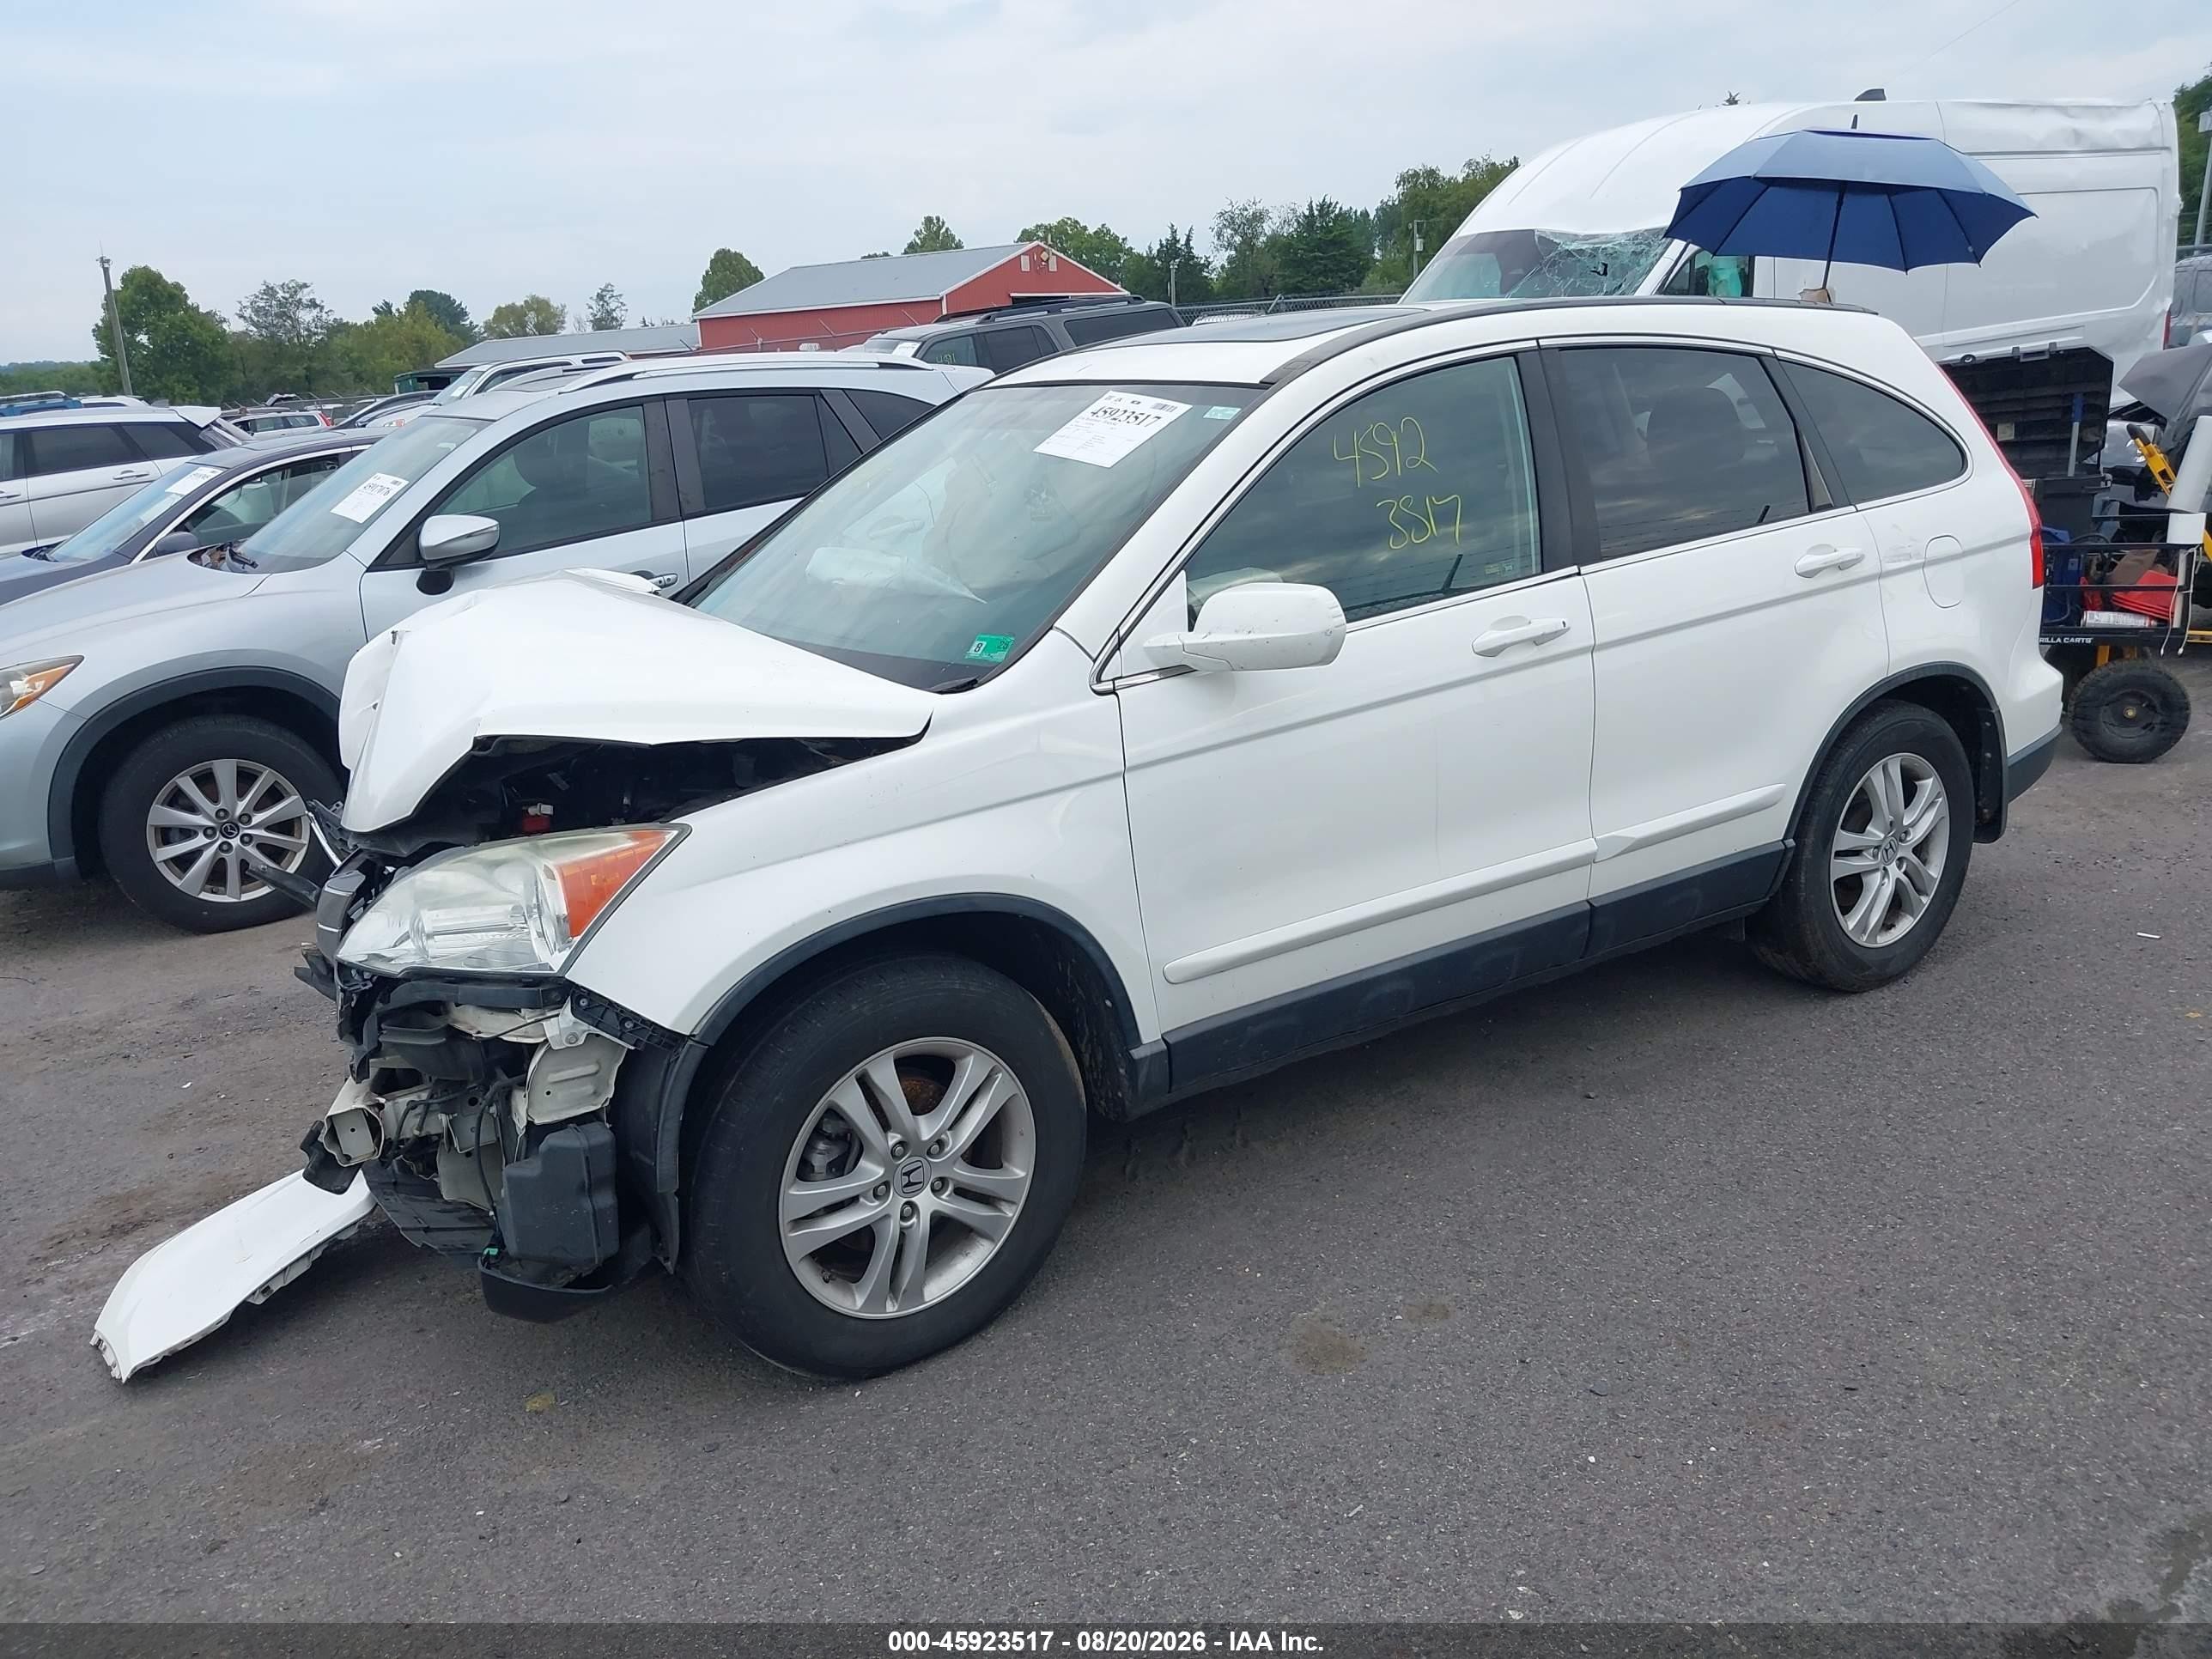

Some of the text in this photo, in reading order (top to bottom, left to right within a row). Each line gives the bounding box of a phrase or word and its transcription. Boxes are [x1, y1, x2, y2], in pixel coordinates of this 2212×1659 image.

[1091, 405, 1162, 428] 45923517
[1333, 417, 1440, 488] 4592
[974, 642, 983, 653] 8
